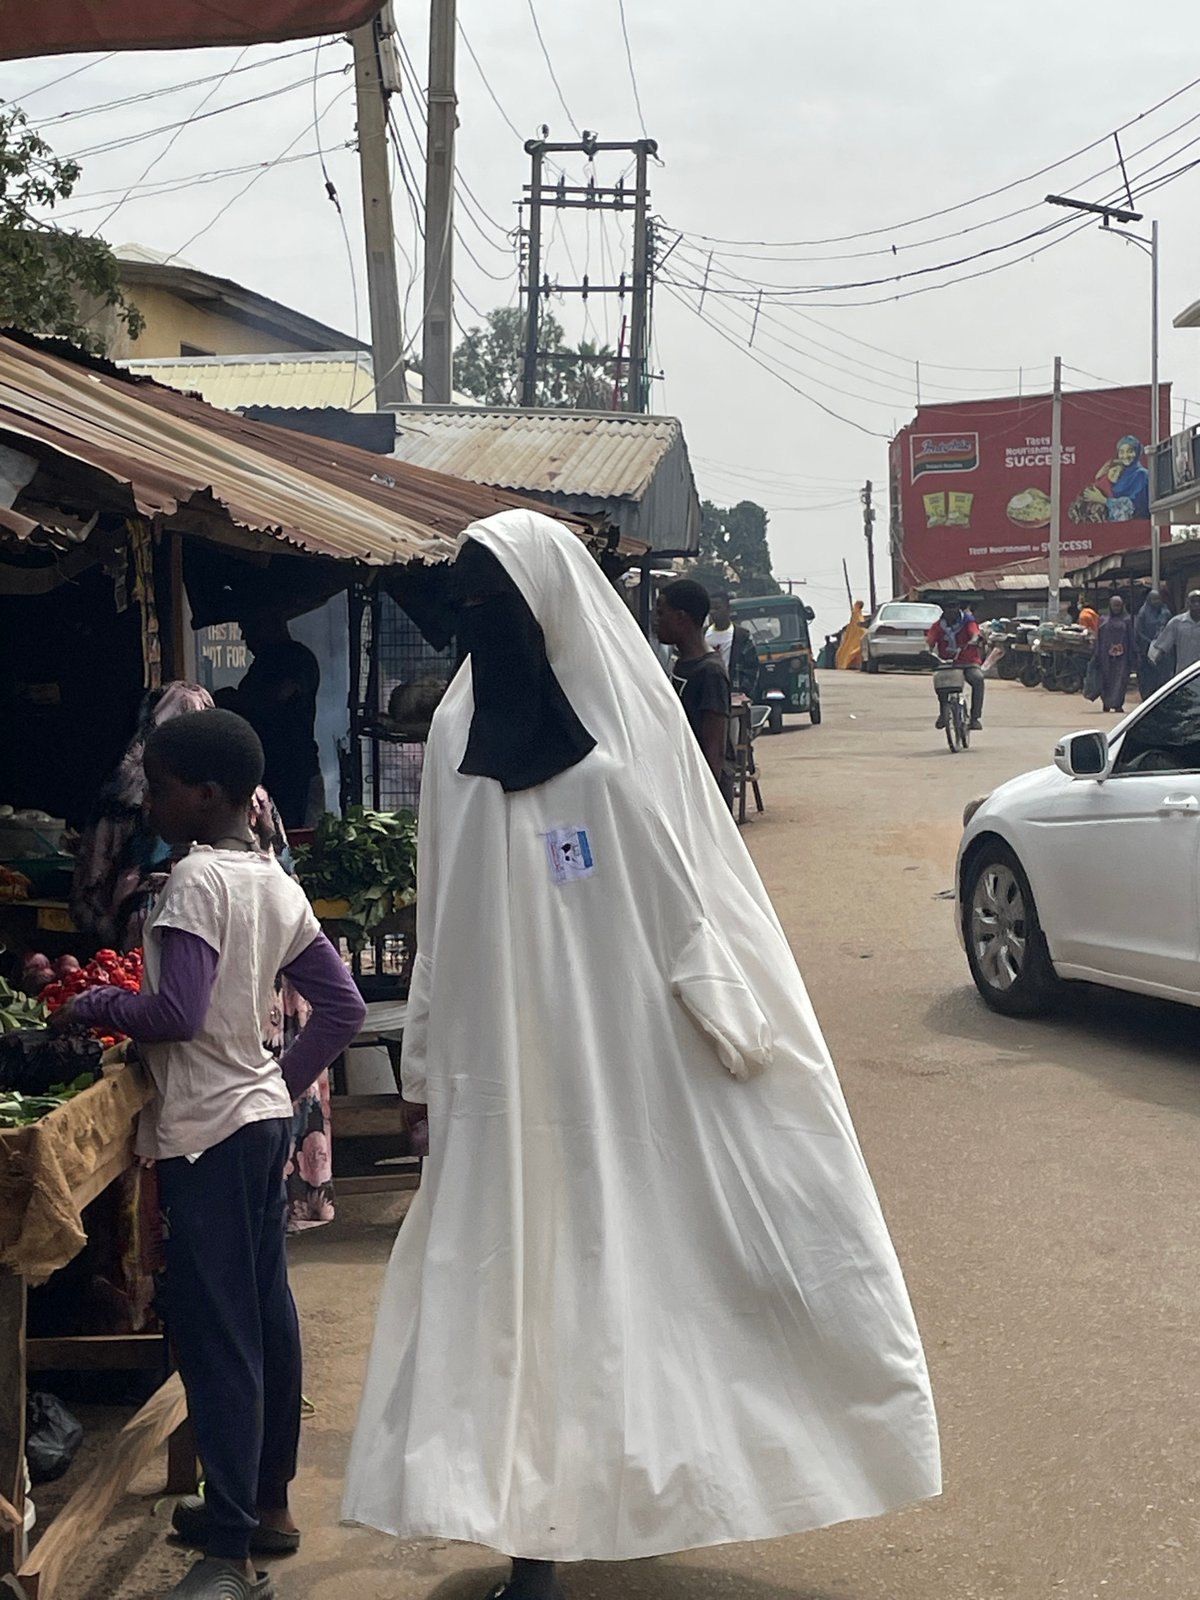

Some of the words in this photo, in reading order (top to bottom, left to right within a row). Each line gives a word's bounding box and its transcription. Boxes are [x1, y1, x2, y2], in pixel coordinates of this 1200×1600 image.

[1025, 436, 1051, 446] Tasty
[1005, 453, 1076, 468] SUCCES!
[1041, 540, 1093, 552] SCESS!
[226, 645, 247, 669] FOR
